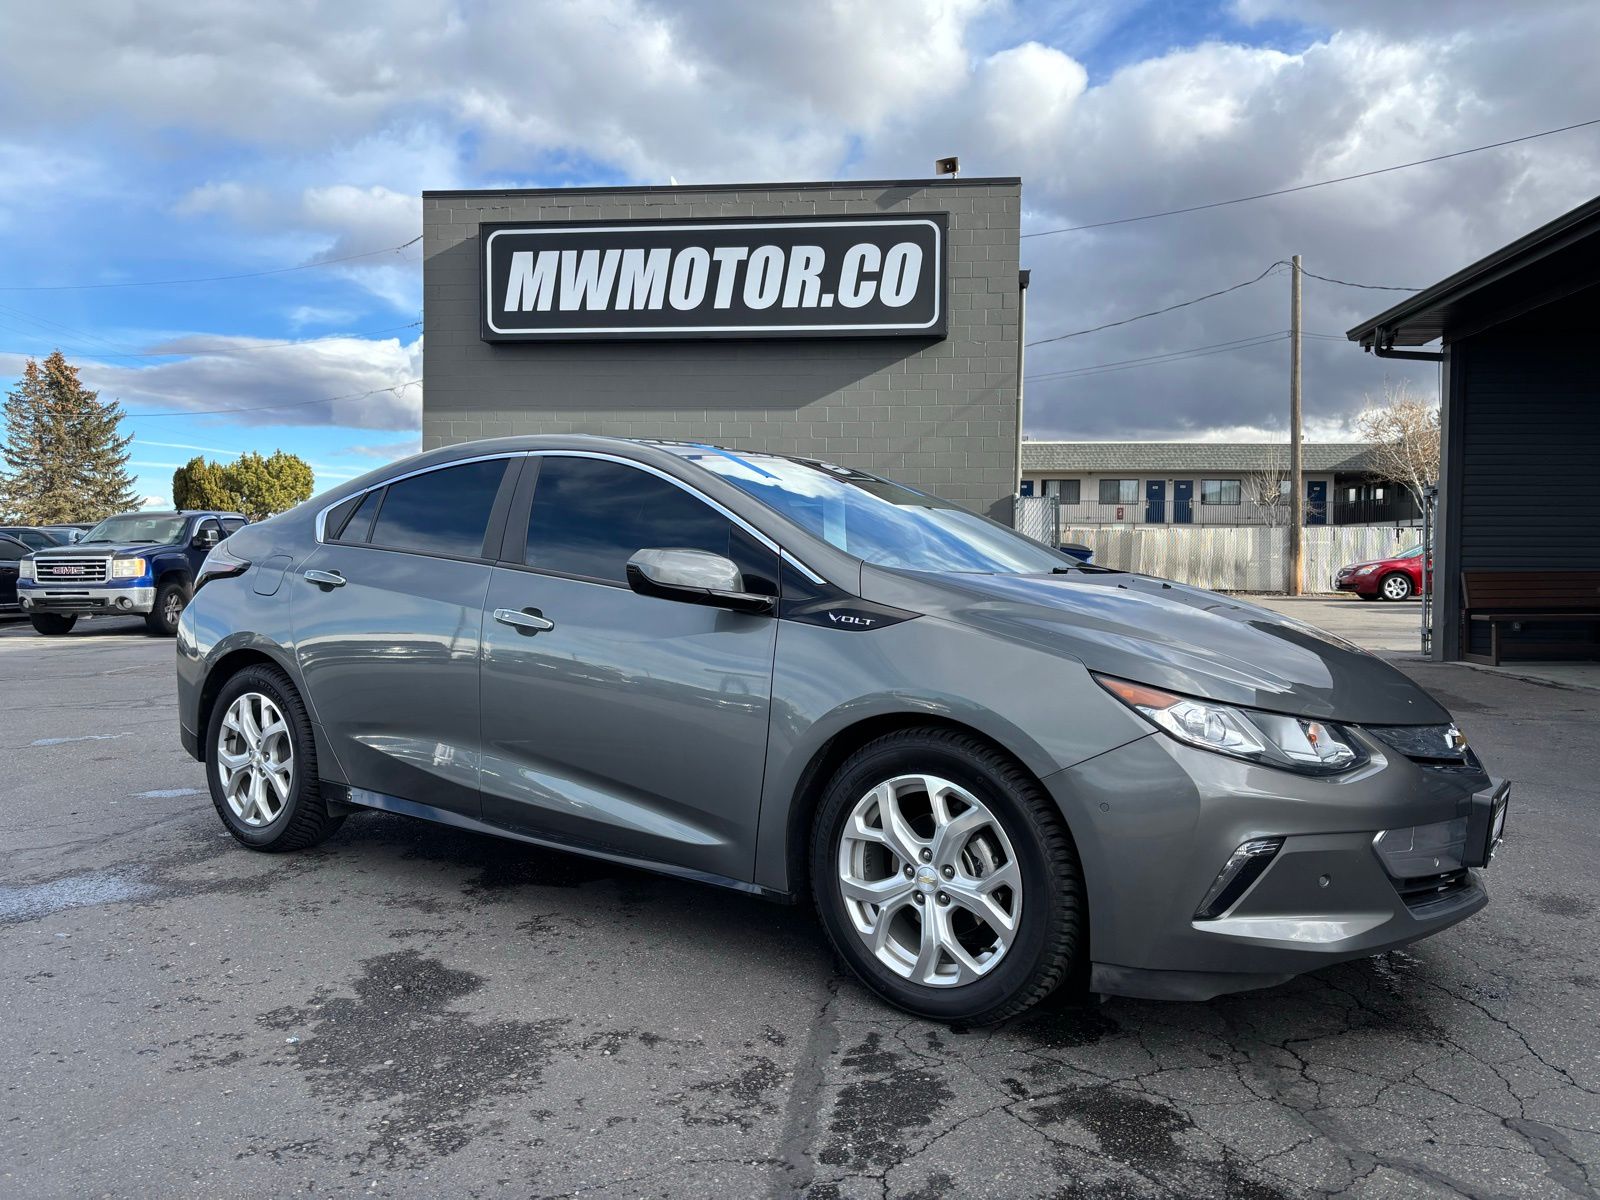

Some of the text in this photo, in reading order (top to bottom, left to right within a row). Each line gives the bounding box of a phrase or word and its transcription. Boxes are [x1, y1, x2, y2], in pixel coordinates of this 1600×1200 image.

[504, 242, 923, 312] MWMOTOR.CO
[53, 566, 84, 574] GMC
[828, 611, 876, 626] VOLT
